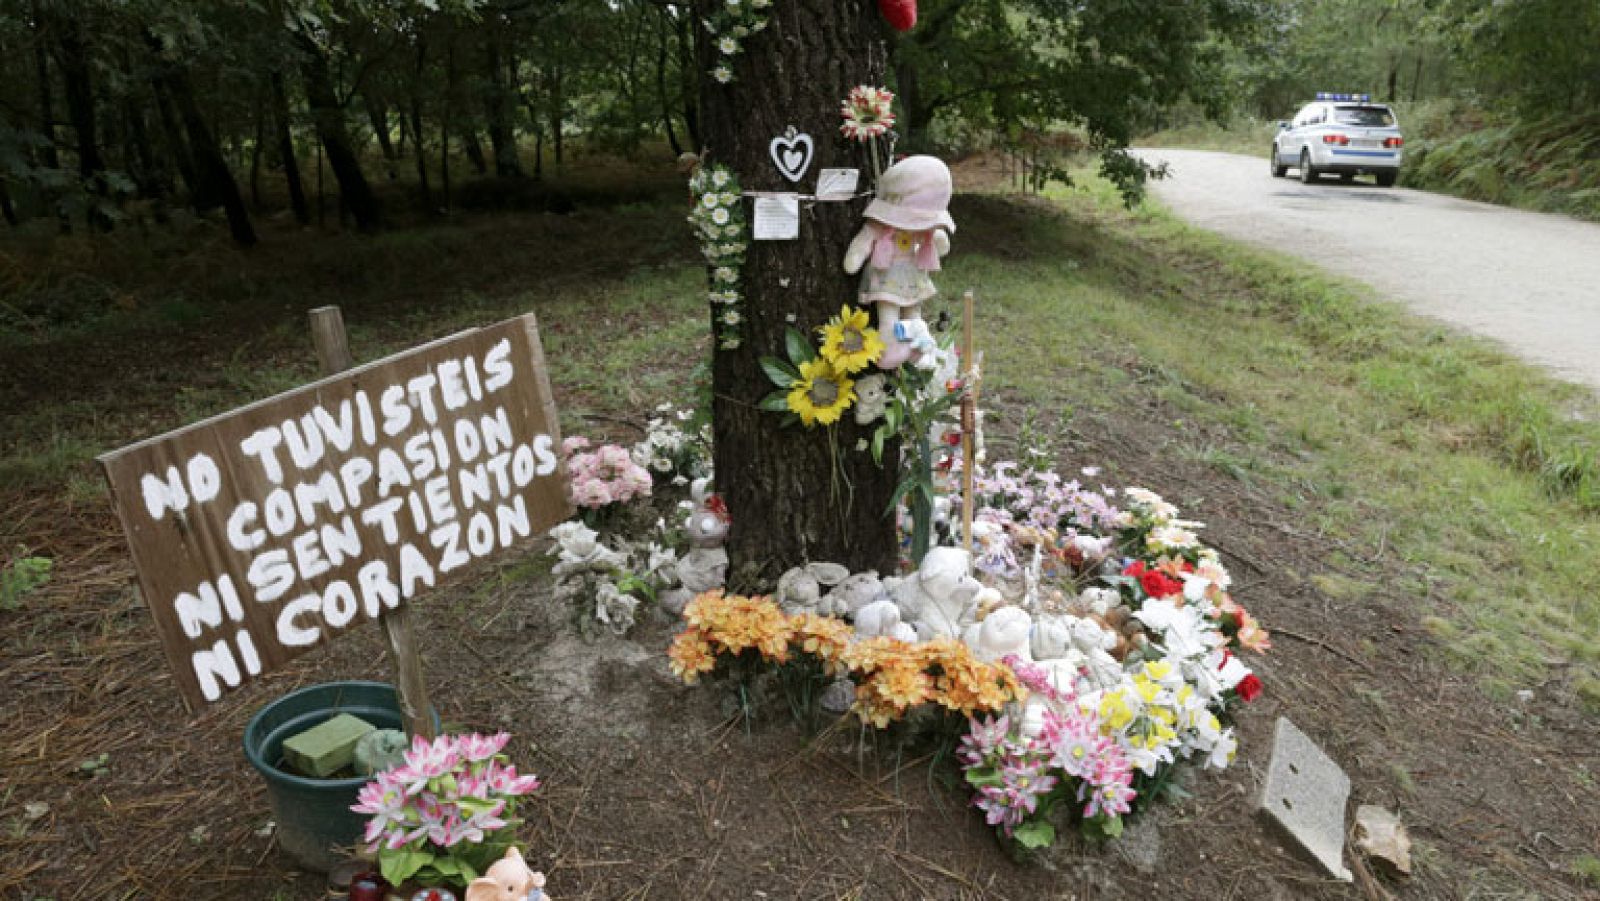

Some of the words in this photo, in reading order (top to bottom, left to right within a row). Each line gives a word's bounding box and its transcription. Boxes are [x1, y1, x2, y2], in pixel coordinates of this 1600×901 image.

[141, 452, 220, 520] NO
[241, 338, 514, 484] TUVISTEIS
[227, 407, 513, 551] COMPASION
[174, 573, 244, 638] NI
[191, 629, 261, 701] NI
[276, 494, 530, 647] CORAZON
